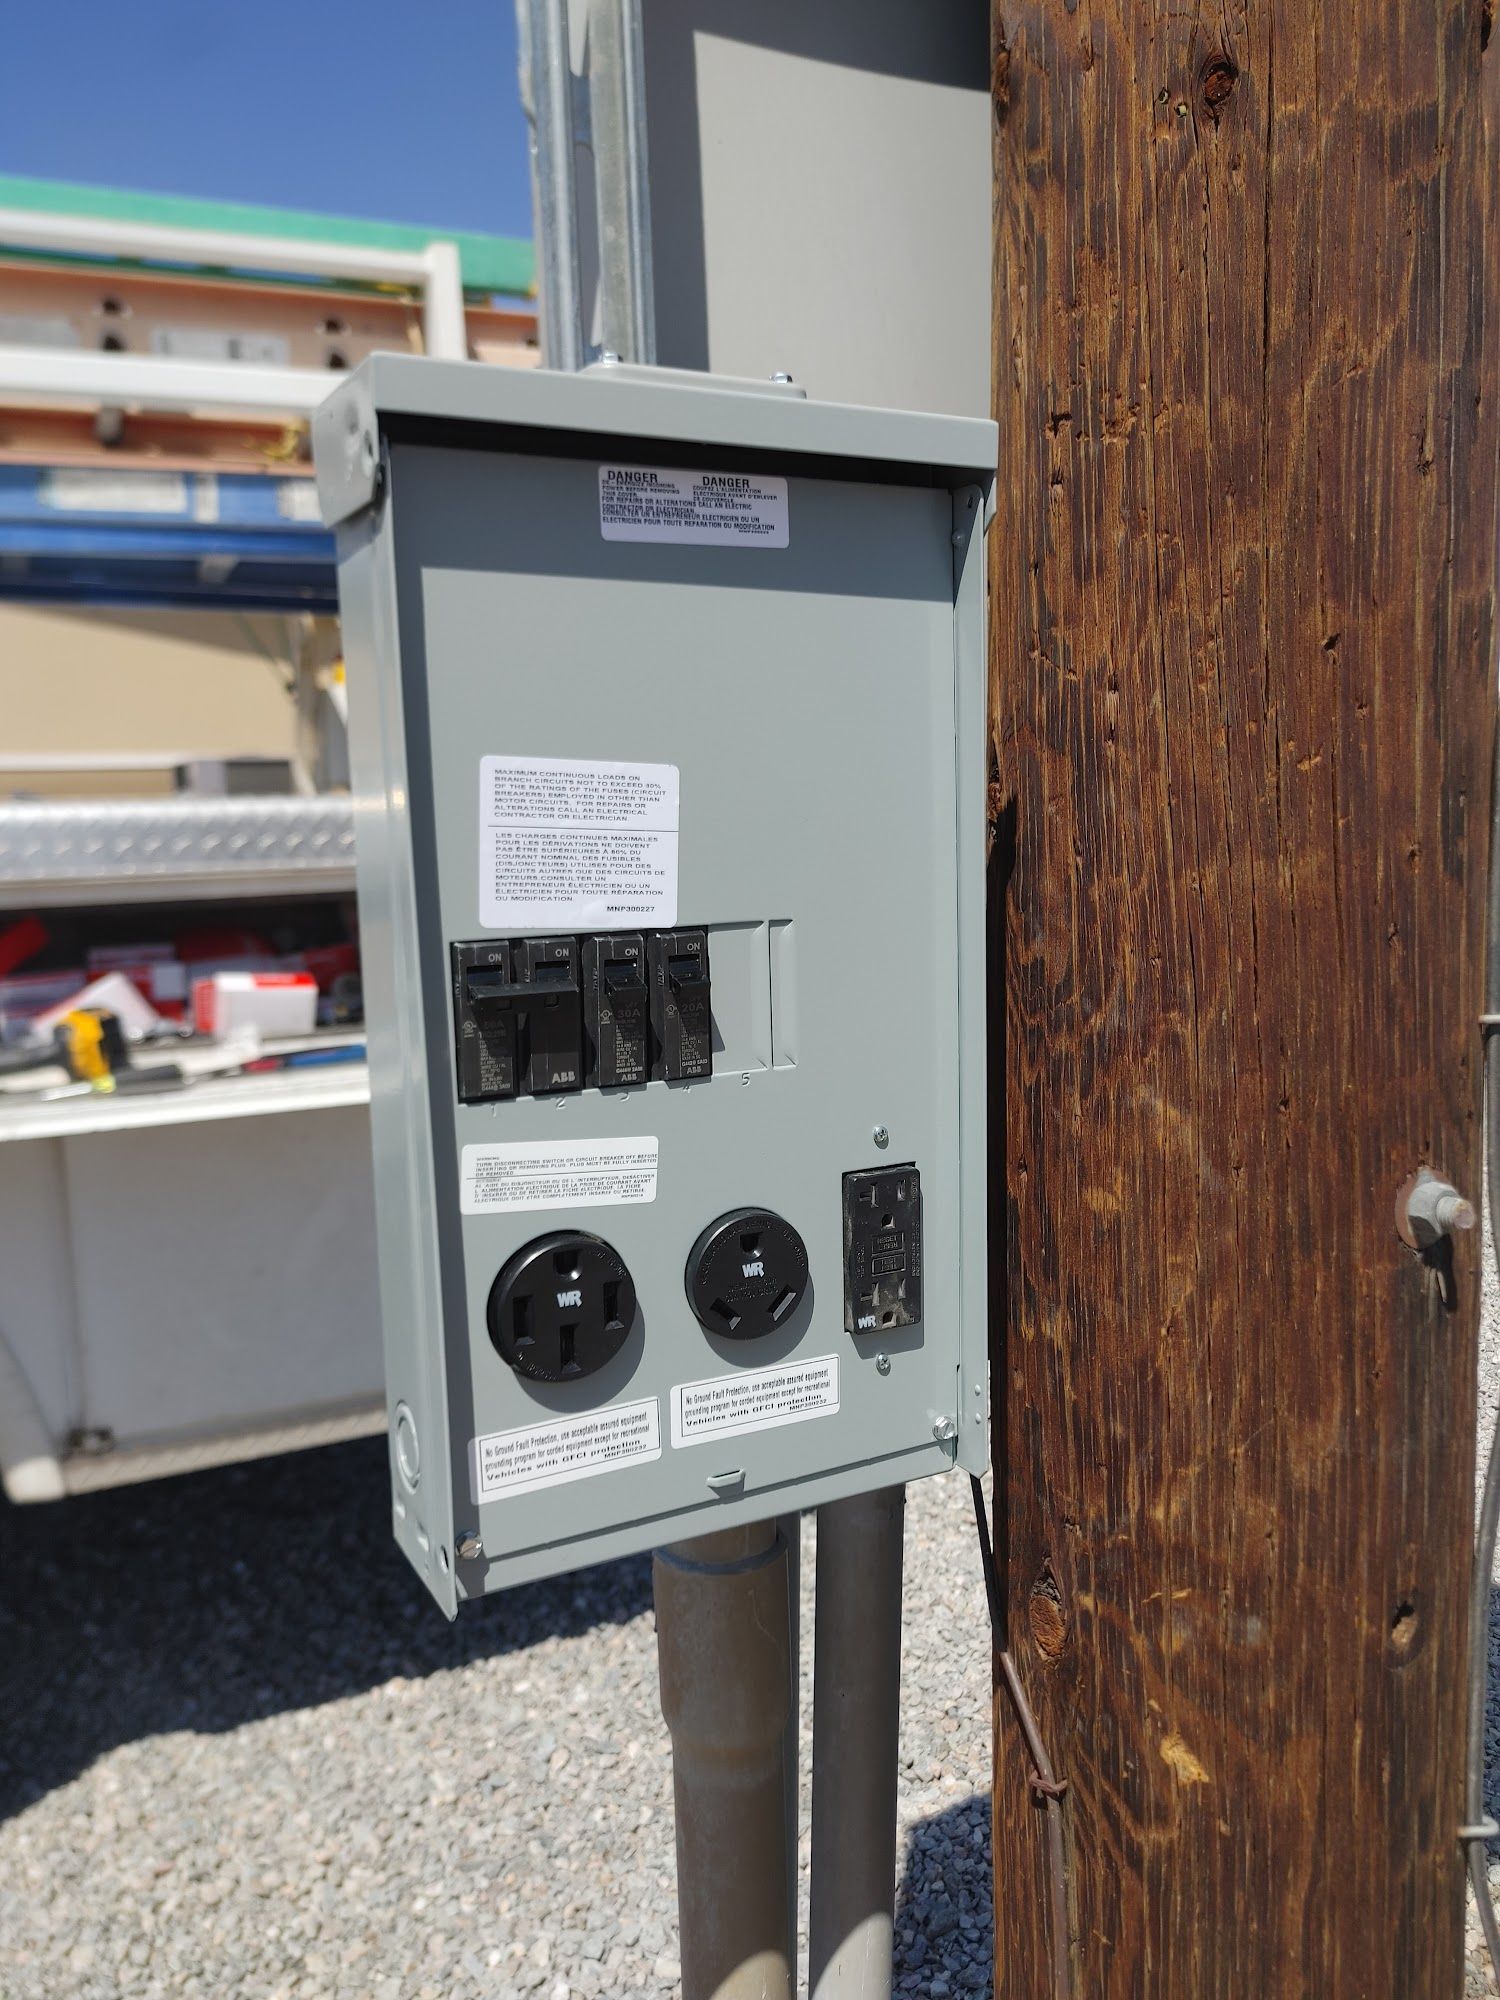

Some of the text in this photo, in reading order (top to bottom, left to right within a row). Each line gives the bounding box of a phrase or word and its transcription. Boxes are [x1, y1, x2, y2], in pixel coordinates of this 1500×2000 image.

[608, 471, 657, 482] DANGER
[703, 476, 750, 488] DANGER
[555, 948, 569, 957] ON
[625, 948, 638, 956] ON
[687, 942, 700, 950] ON
[488, 953, 501, 962] ON
[686, 1066, 701, 1074] ABB
[552, 1071, 575, 1083] ABB
[621, 1073, 637, 1081] ABB
[742, 1072, 750, 1085] 5
[556, 1097, 566, 1110] 2
[742, 1262, 764, 1278] WR
[557, 1290, 582, 1308] WR
[858, 1315, 876, 1329] WR
[686, 1396, 692, 1405] No
[694, 1392, 710, 1404] Ground
[713, 1389, 724, 1400] Fault
[762, 1377, 785, 1389] acceptable
[787, 1373, 803, 1385] assured
[805, 1369, 828, 1381] equipment
[685, 1406, 709, 1418] grounding
[711, 1402, 729, 1414] program
[740, 1396, 754, 1406] corded
[757, 1391, 780, 1403] equipment
[781, 1387, 795, 1397] except
[804, 1380, 830, 1391] recreational
[686, 1395, 821, 1426] Vehicles with GFCI protection
[486, 1448, 493, 1457] No
[495, 1443, 514, 1456] Ground
[516, 1439, 529, 1450] Fault
[561, 1431, 569, 1440] use
[572, 1423, 598, 1437] acceptable
[600, 1417, 619, 1431] assured
[621, 1411, 647, 1426] equipment
[486, 1458, 512, 1472] grounding
[515, 1453, 536, 1465] program
[547, 1443, 564, 1455] corded
[566, 1438, 592, 1452] equipment
[595, 1432, 610, 1444] except
[621, 1424, 649, 1438] recreational
[487, 1440, 640, 1481] Vehicles with GFCI protection
